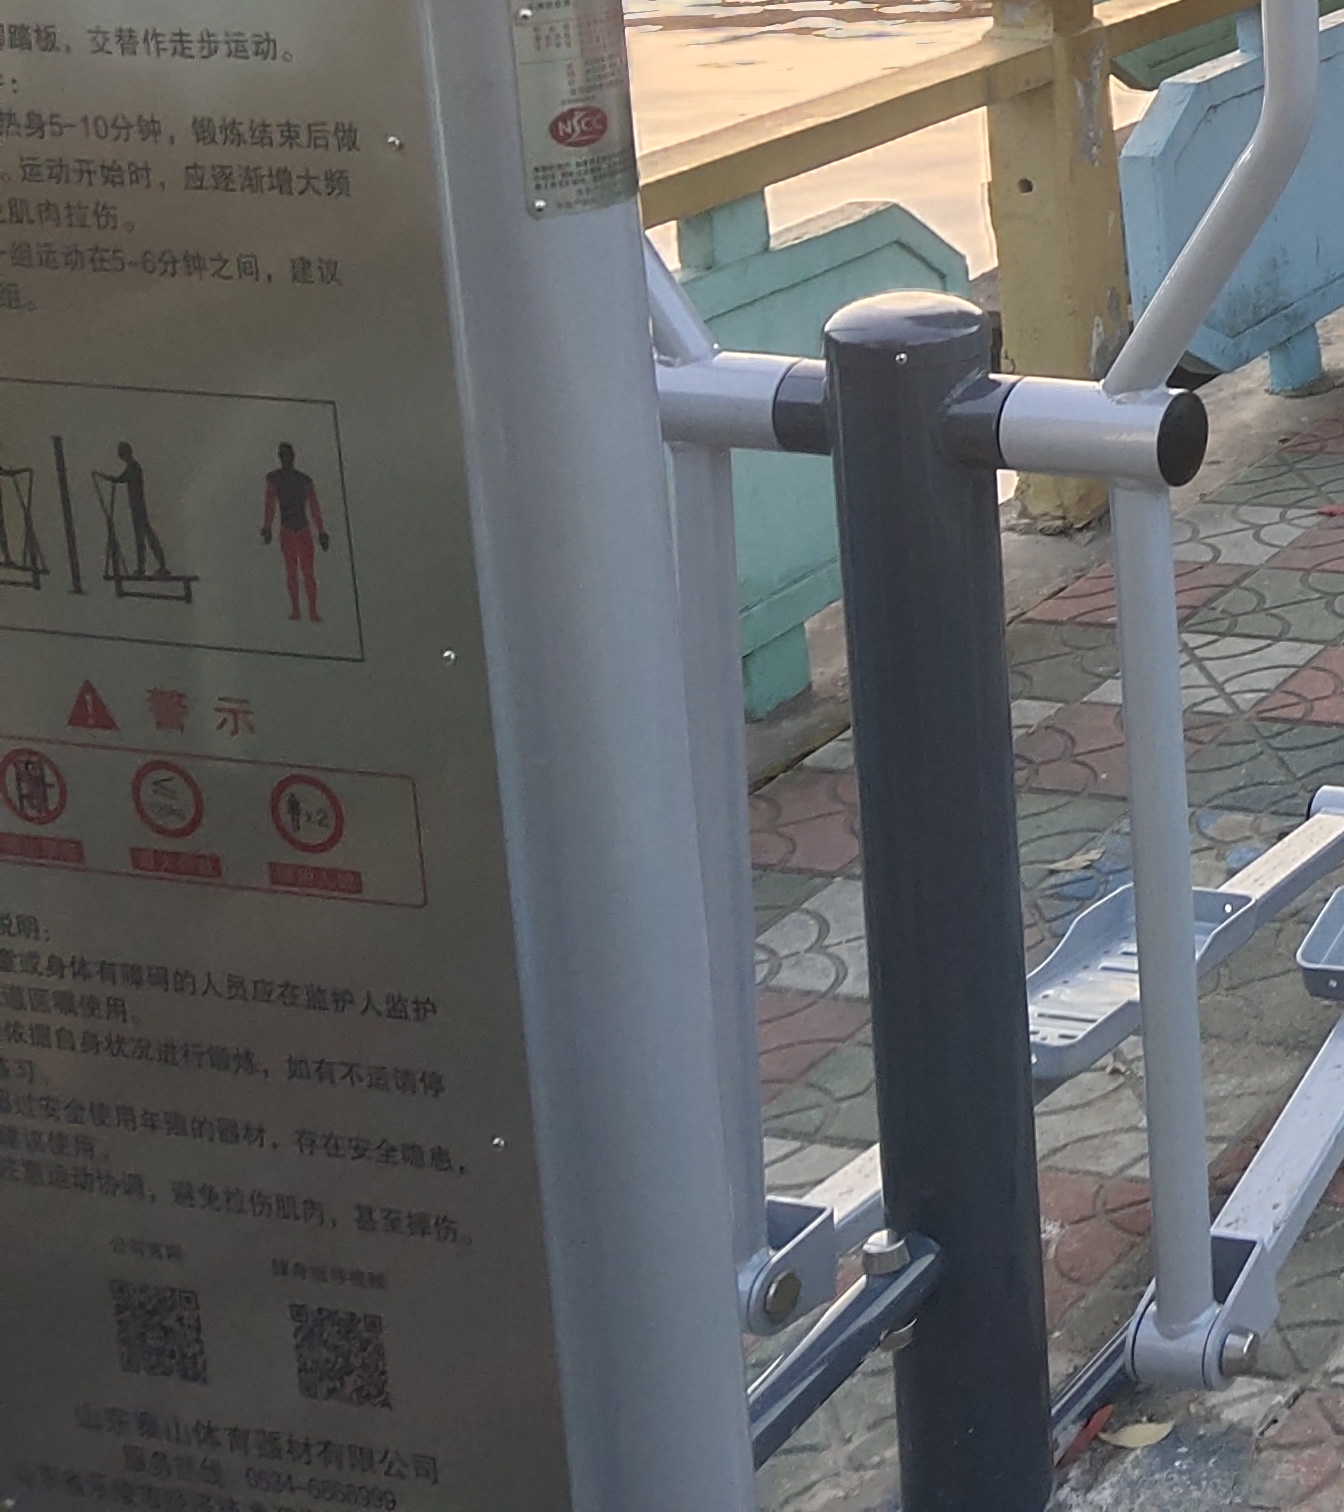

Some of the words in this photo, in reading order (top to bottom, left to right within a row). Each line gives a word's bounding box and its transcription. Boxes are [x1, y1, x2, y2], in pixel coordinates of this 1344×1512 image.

[0, 23, 294, 63] 踏板，交替作走步运动。
[0, 197, 135, 233] 肌肉拉伤。
[0, 241, 343, 286] 组运动在5-6分钟之间，建议
[146, 686, 256, 736] 警示
